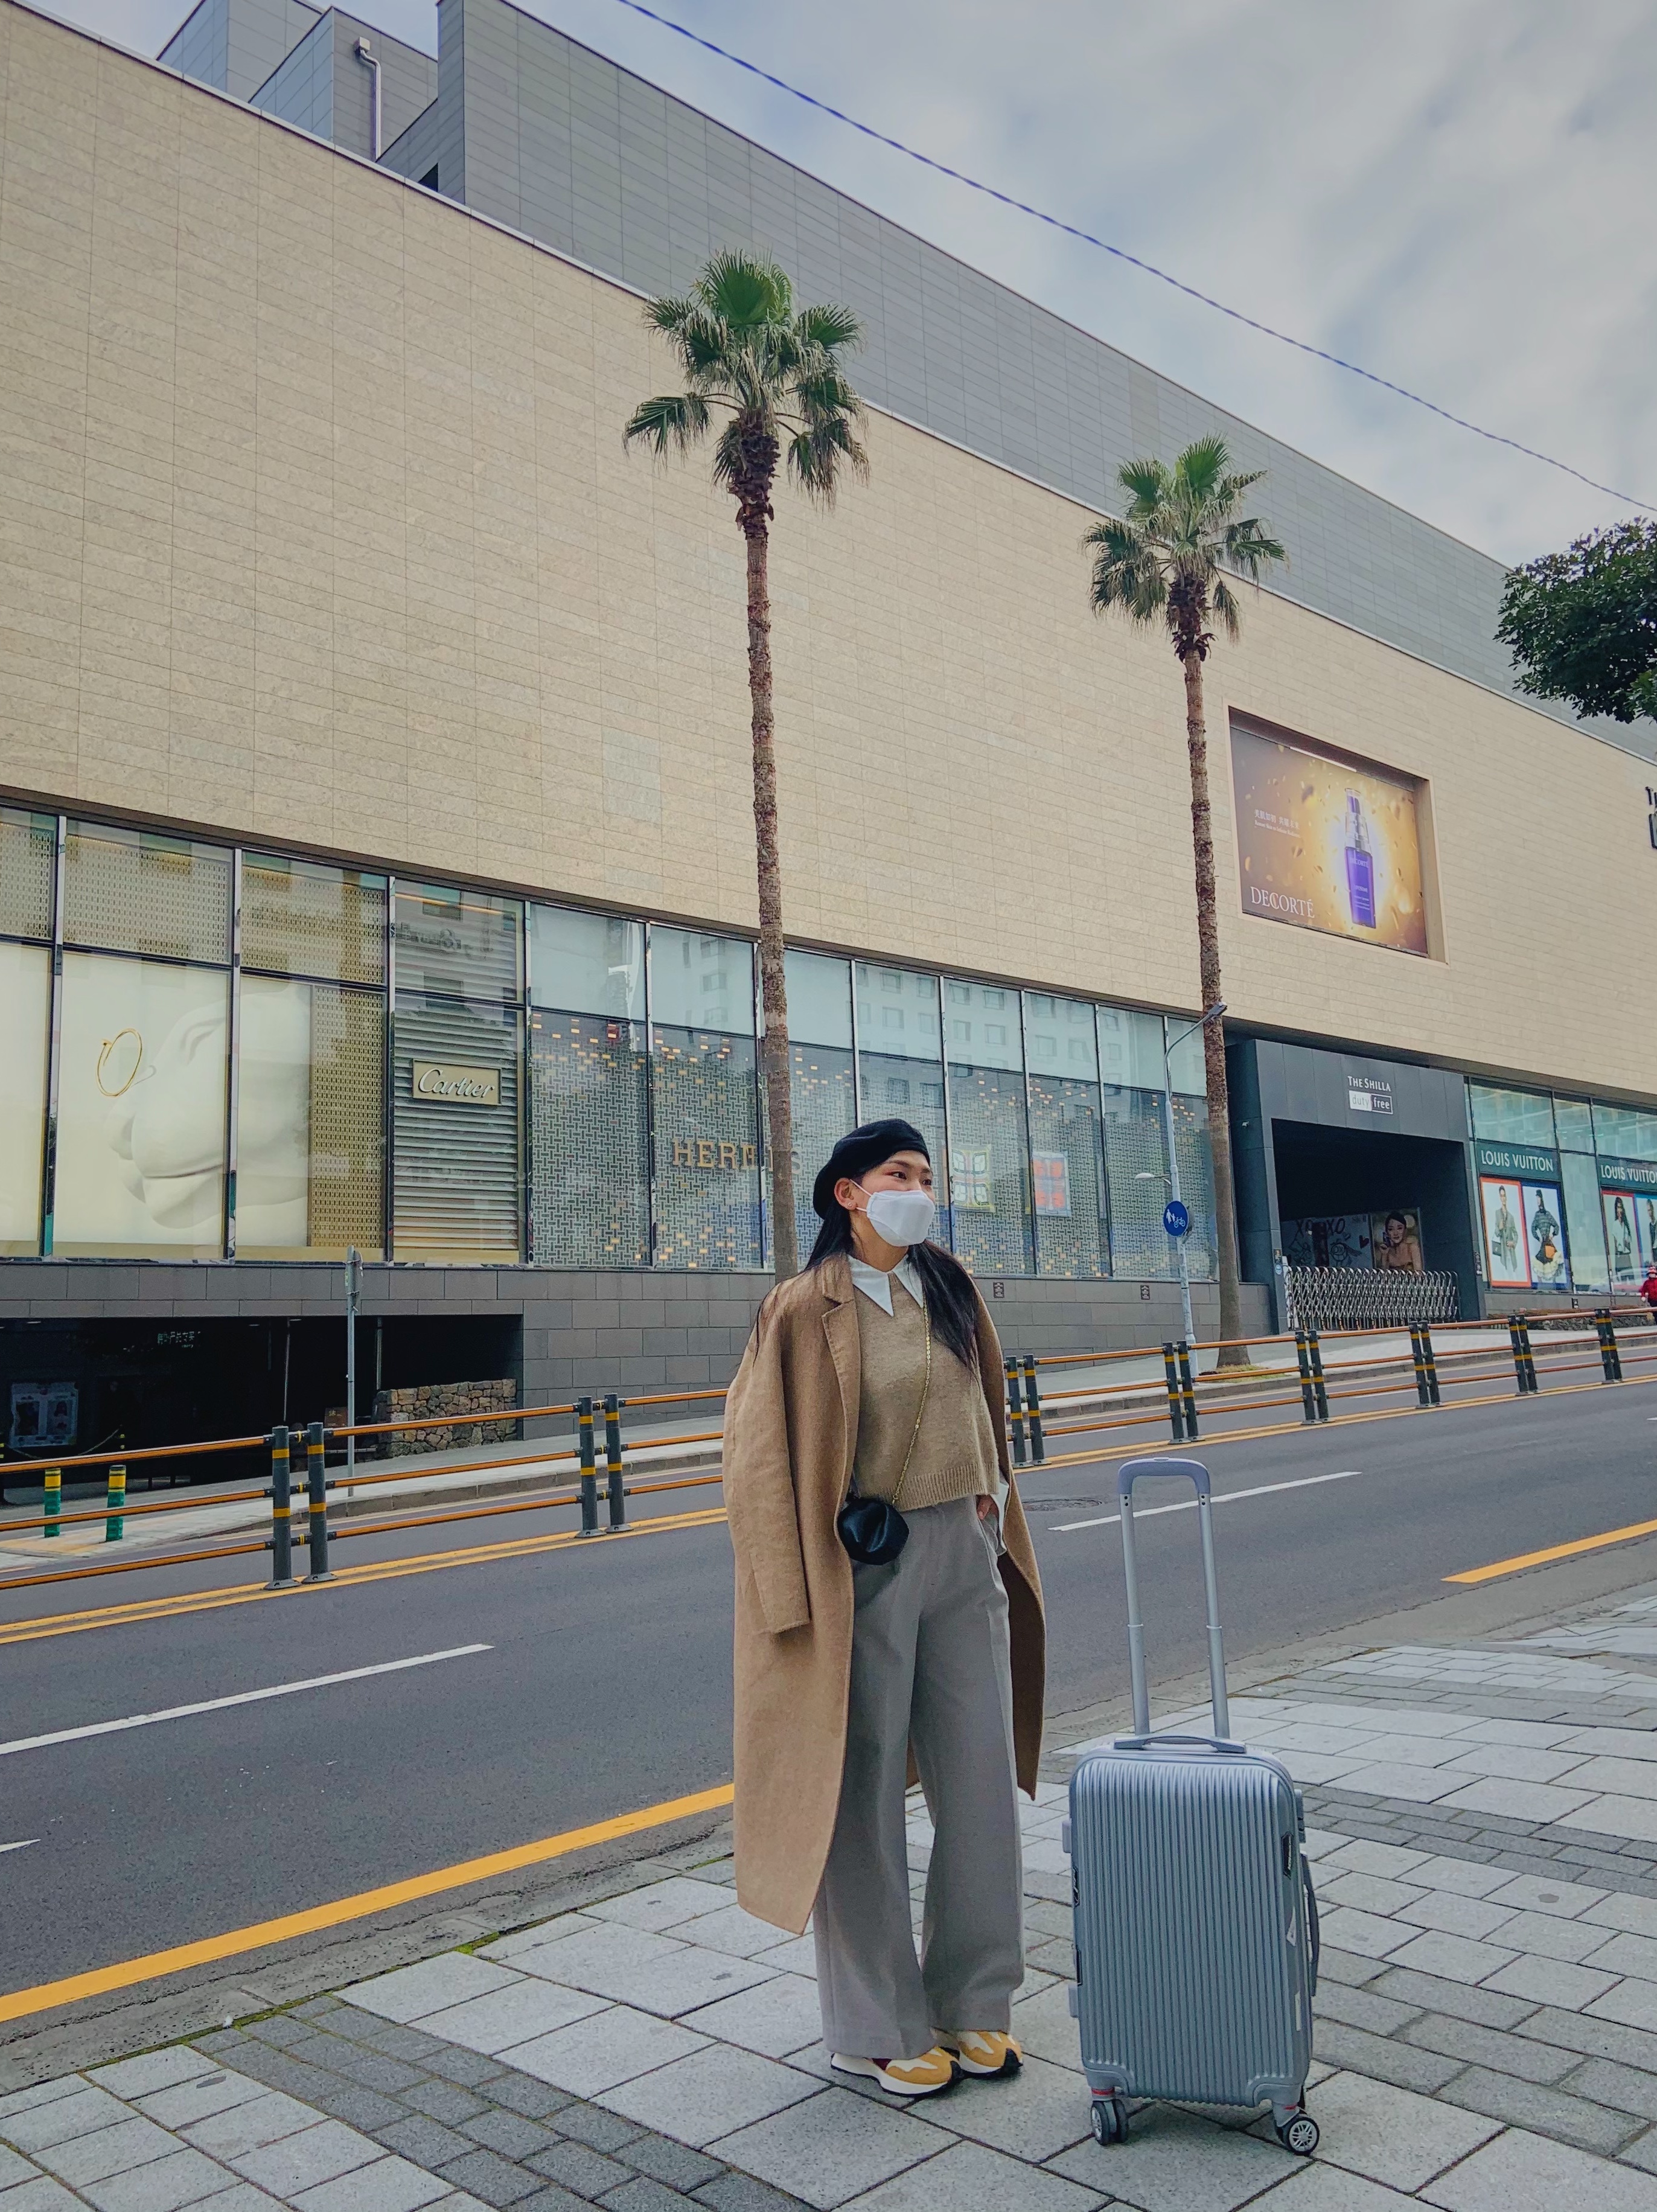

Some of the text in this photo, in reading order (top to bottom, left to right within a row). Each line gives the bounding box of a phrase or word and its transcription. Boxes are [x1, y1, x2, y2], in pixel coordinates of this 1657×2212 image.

[1250, 886, 1315, 918] DECORTÉ
[418, 1068, 495, 1098] Cartier
[1347, 1076, 1391, 1092] THE SHILLA
[1352, 1095, 1390, 1109] duty free
[671, 1137, 802, 1174] HERMS
[1481, 1149, 1553, 1172] LOUIS VUITTON
[1601, 1165, 1657, 1183] LOUIS VUITTO
